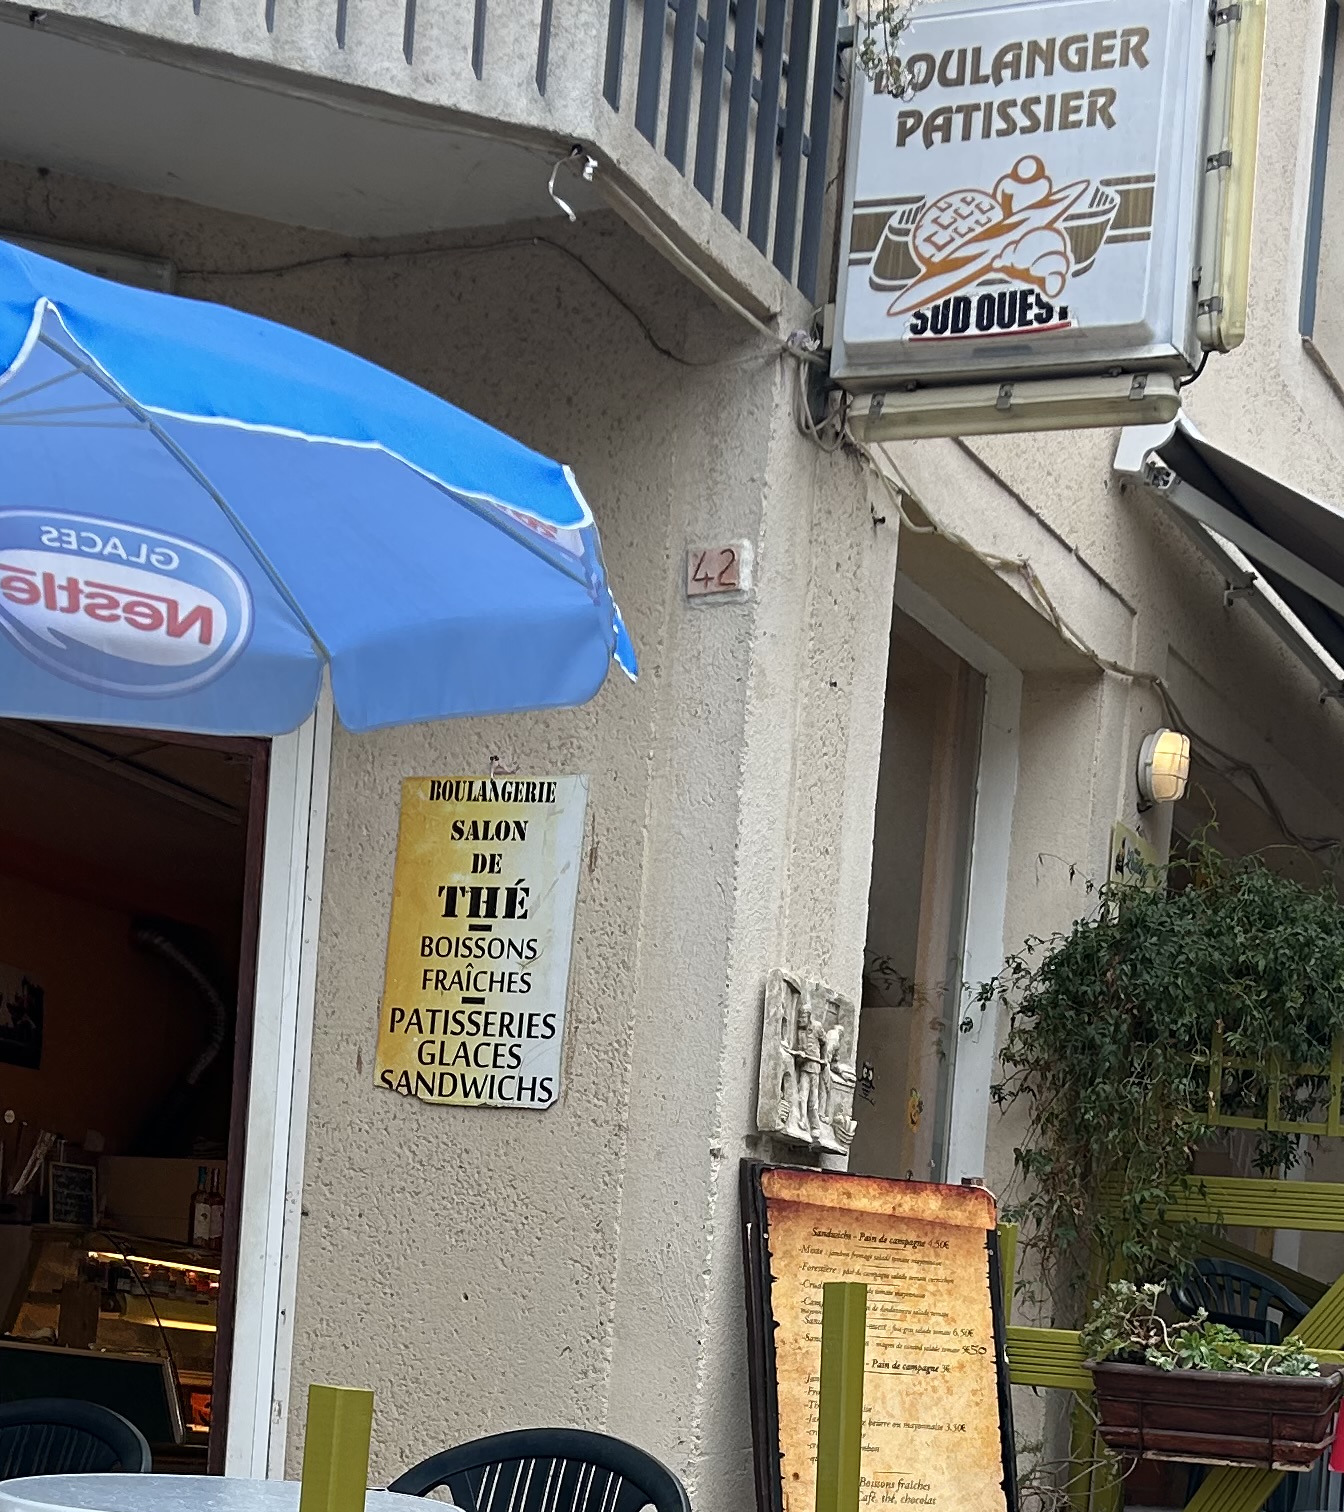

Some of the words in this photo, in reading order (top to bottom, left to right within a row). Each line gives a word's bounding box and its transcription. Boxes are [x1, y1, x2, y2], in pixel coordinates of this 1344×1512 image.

[896, 87, 1117, 148] PATISSIER
[910, 295, 972, 335] SUD
[692, 549, 736, 589] 42
[429, 780, 557, 803] BOULANGERIE
[451, 820, 529, 842] SALON
[471, 853, 503, 874] DE
[438, 878, 530, 919] THÉ
[420, 936, 538, 960] BOISSONS
[422, 963, 532, 993] FRAÎCHES
[389, 1007, 557, 1039] PATISSERIES
[417, 1040, 522, 1069] GLACES
[380, 1069, 553, 1103] SANDWICHS
